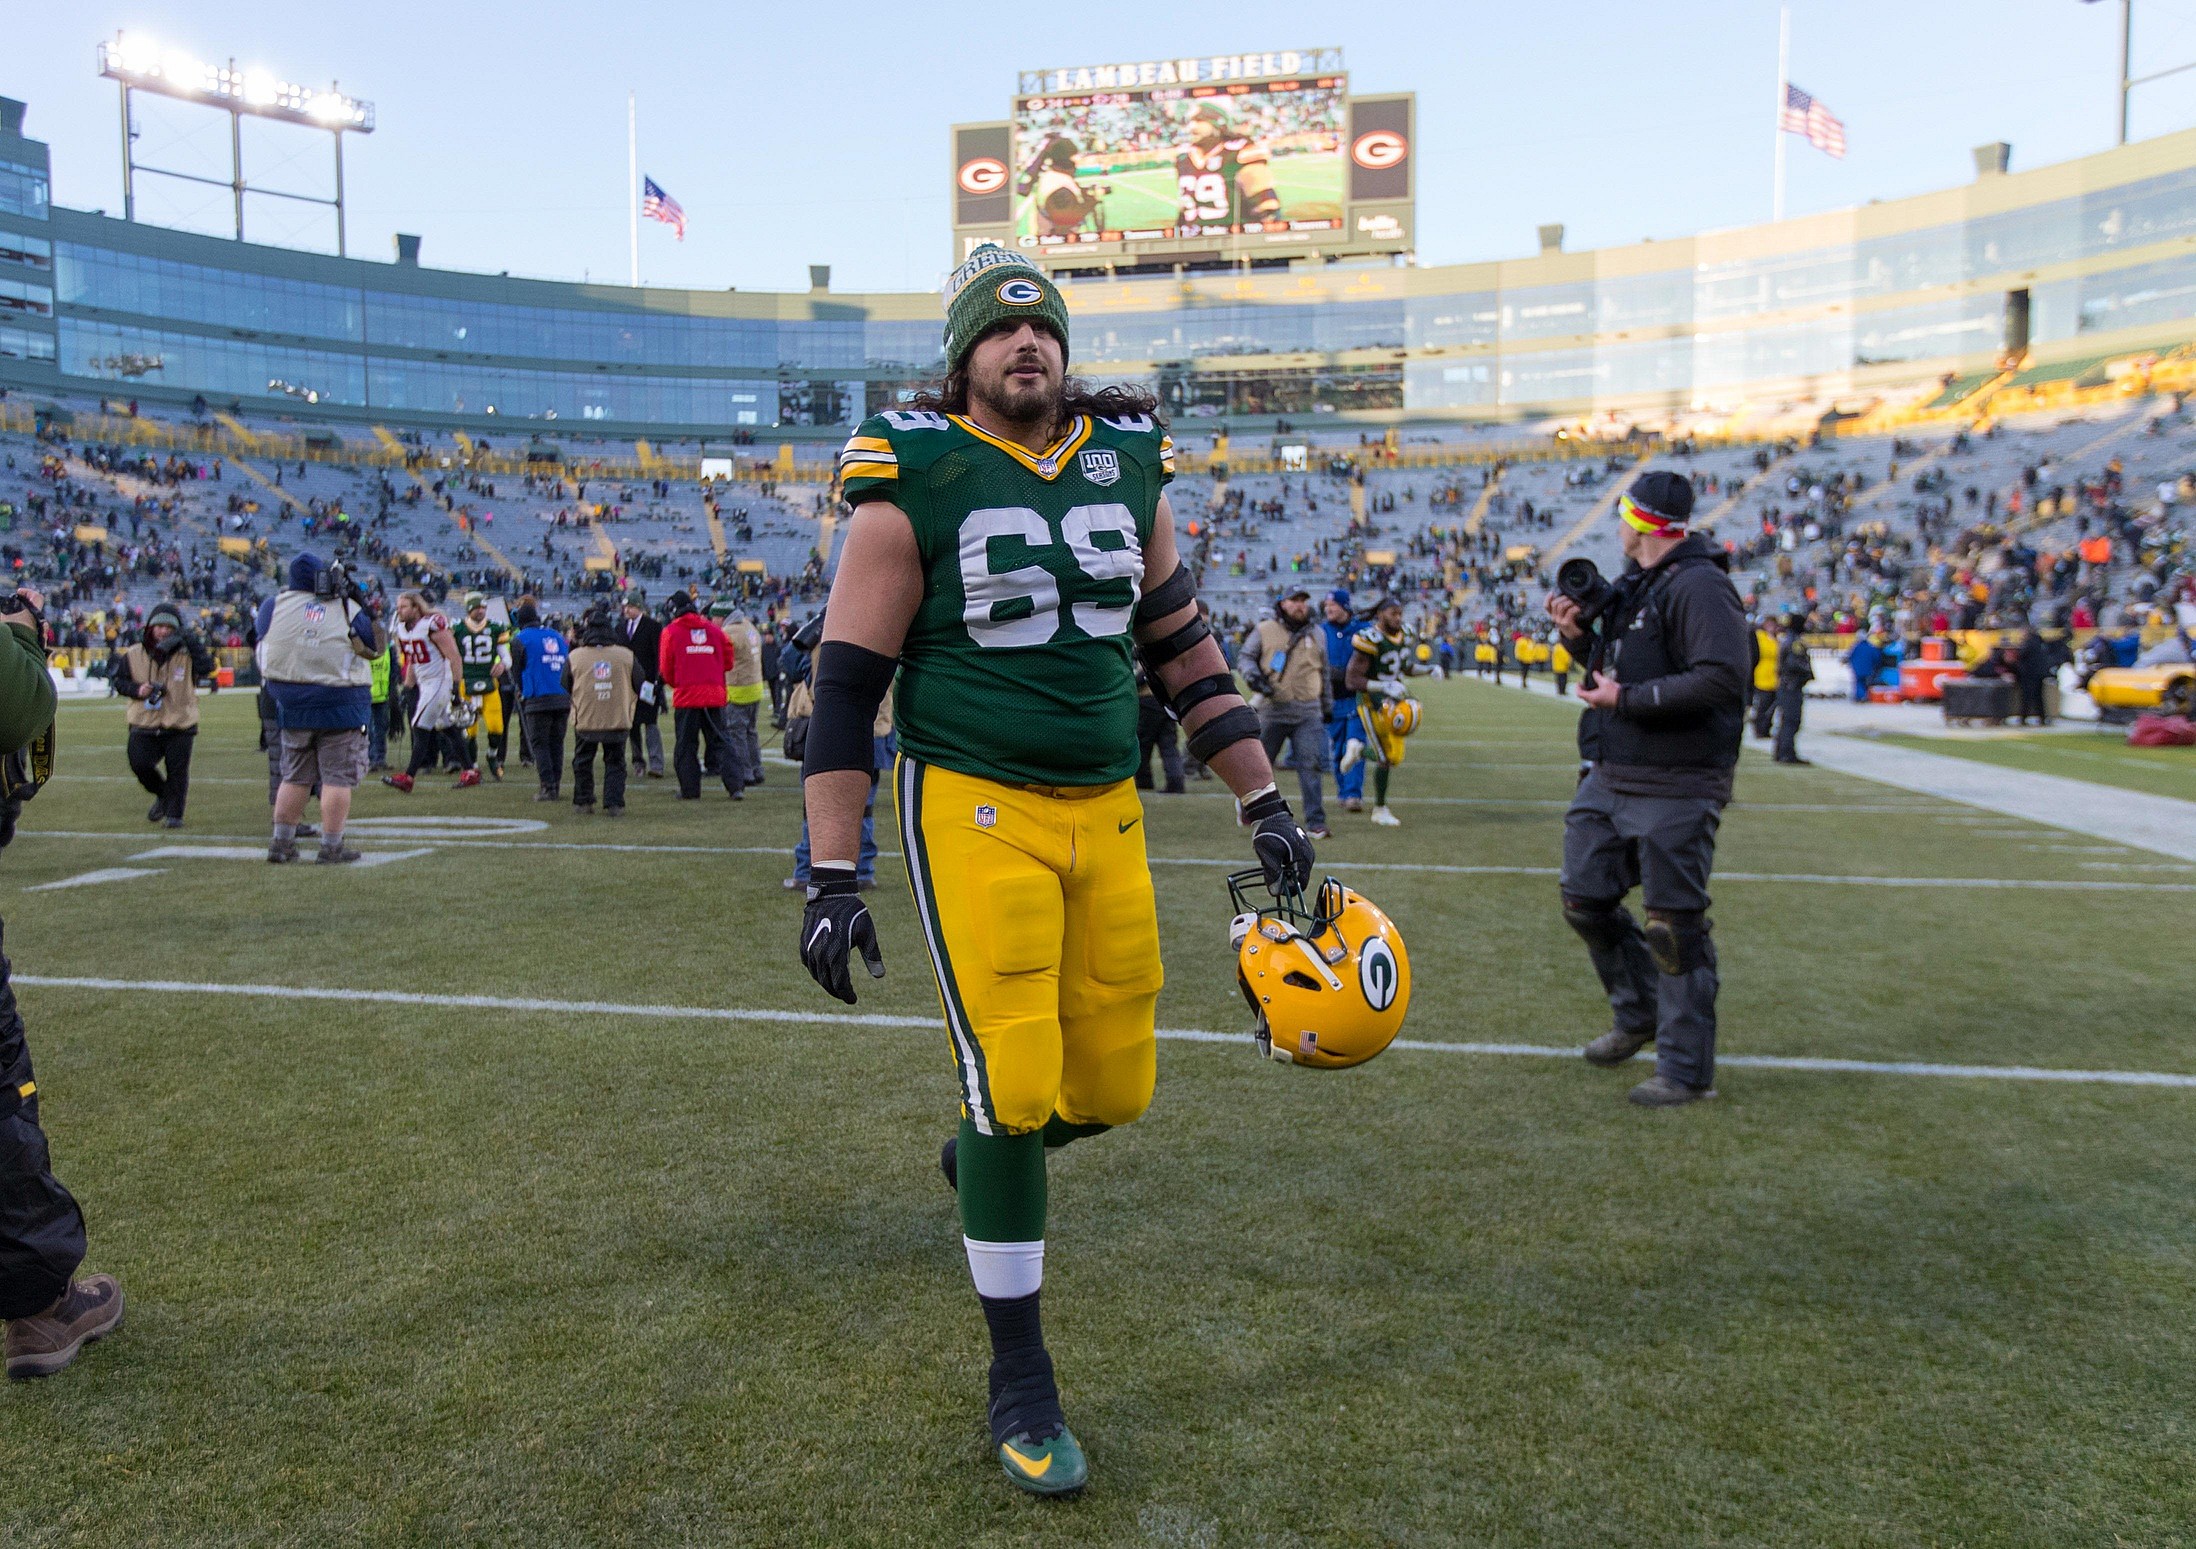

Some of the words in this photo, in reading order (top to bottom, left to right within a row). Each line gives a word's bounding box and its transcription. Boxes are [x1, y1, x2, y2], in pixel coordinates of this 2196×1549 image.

[1057, 58, 1200, 92] LAMBEAU
[1210, 50, 1301, 80] FIELD
[998, 280, 1043, 305] G
[1085, 454, 1114, 469] 100
[1092, 469, 1116, 481] SEASONS
[958, 503, 1145, 648] 69
[462, 634, 493, 664] 12
